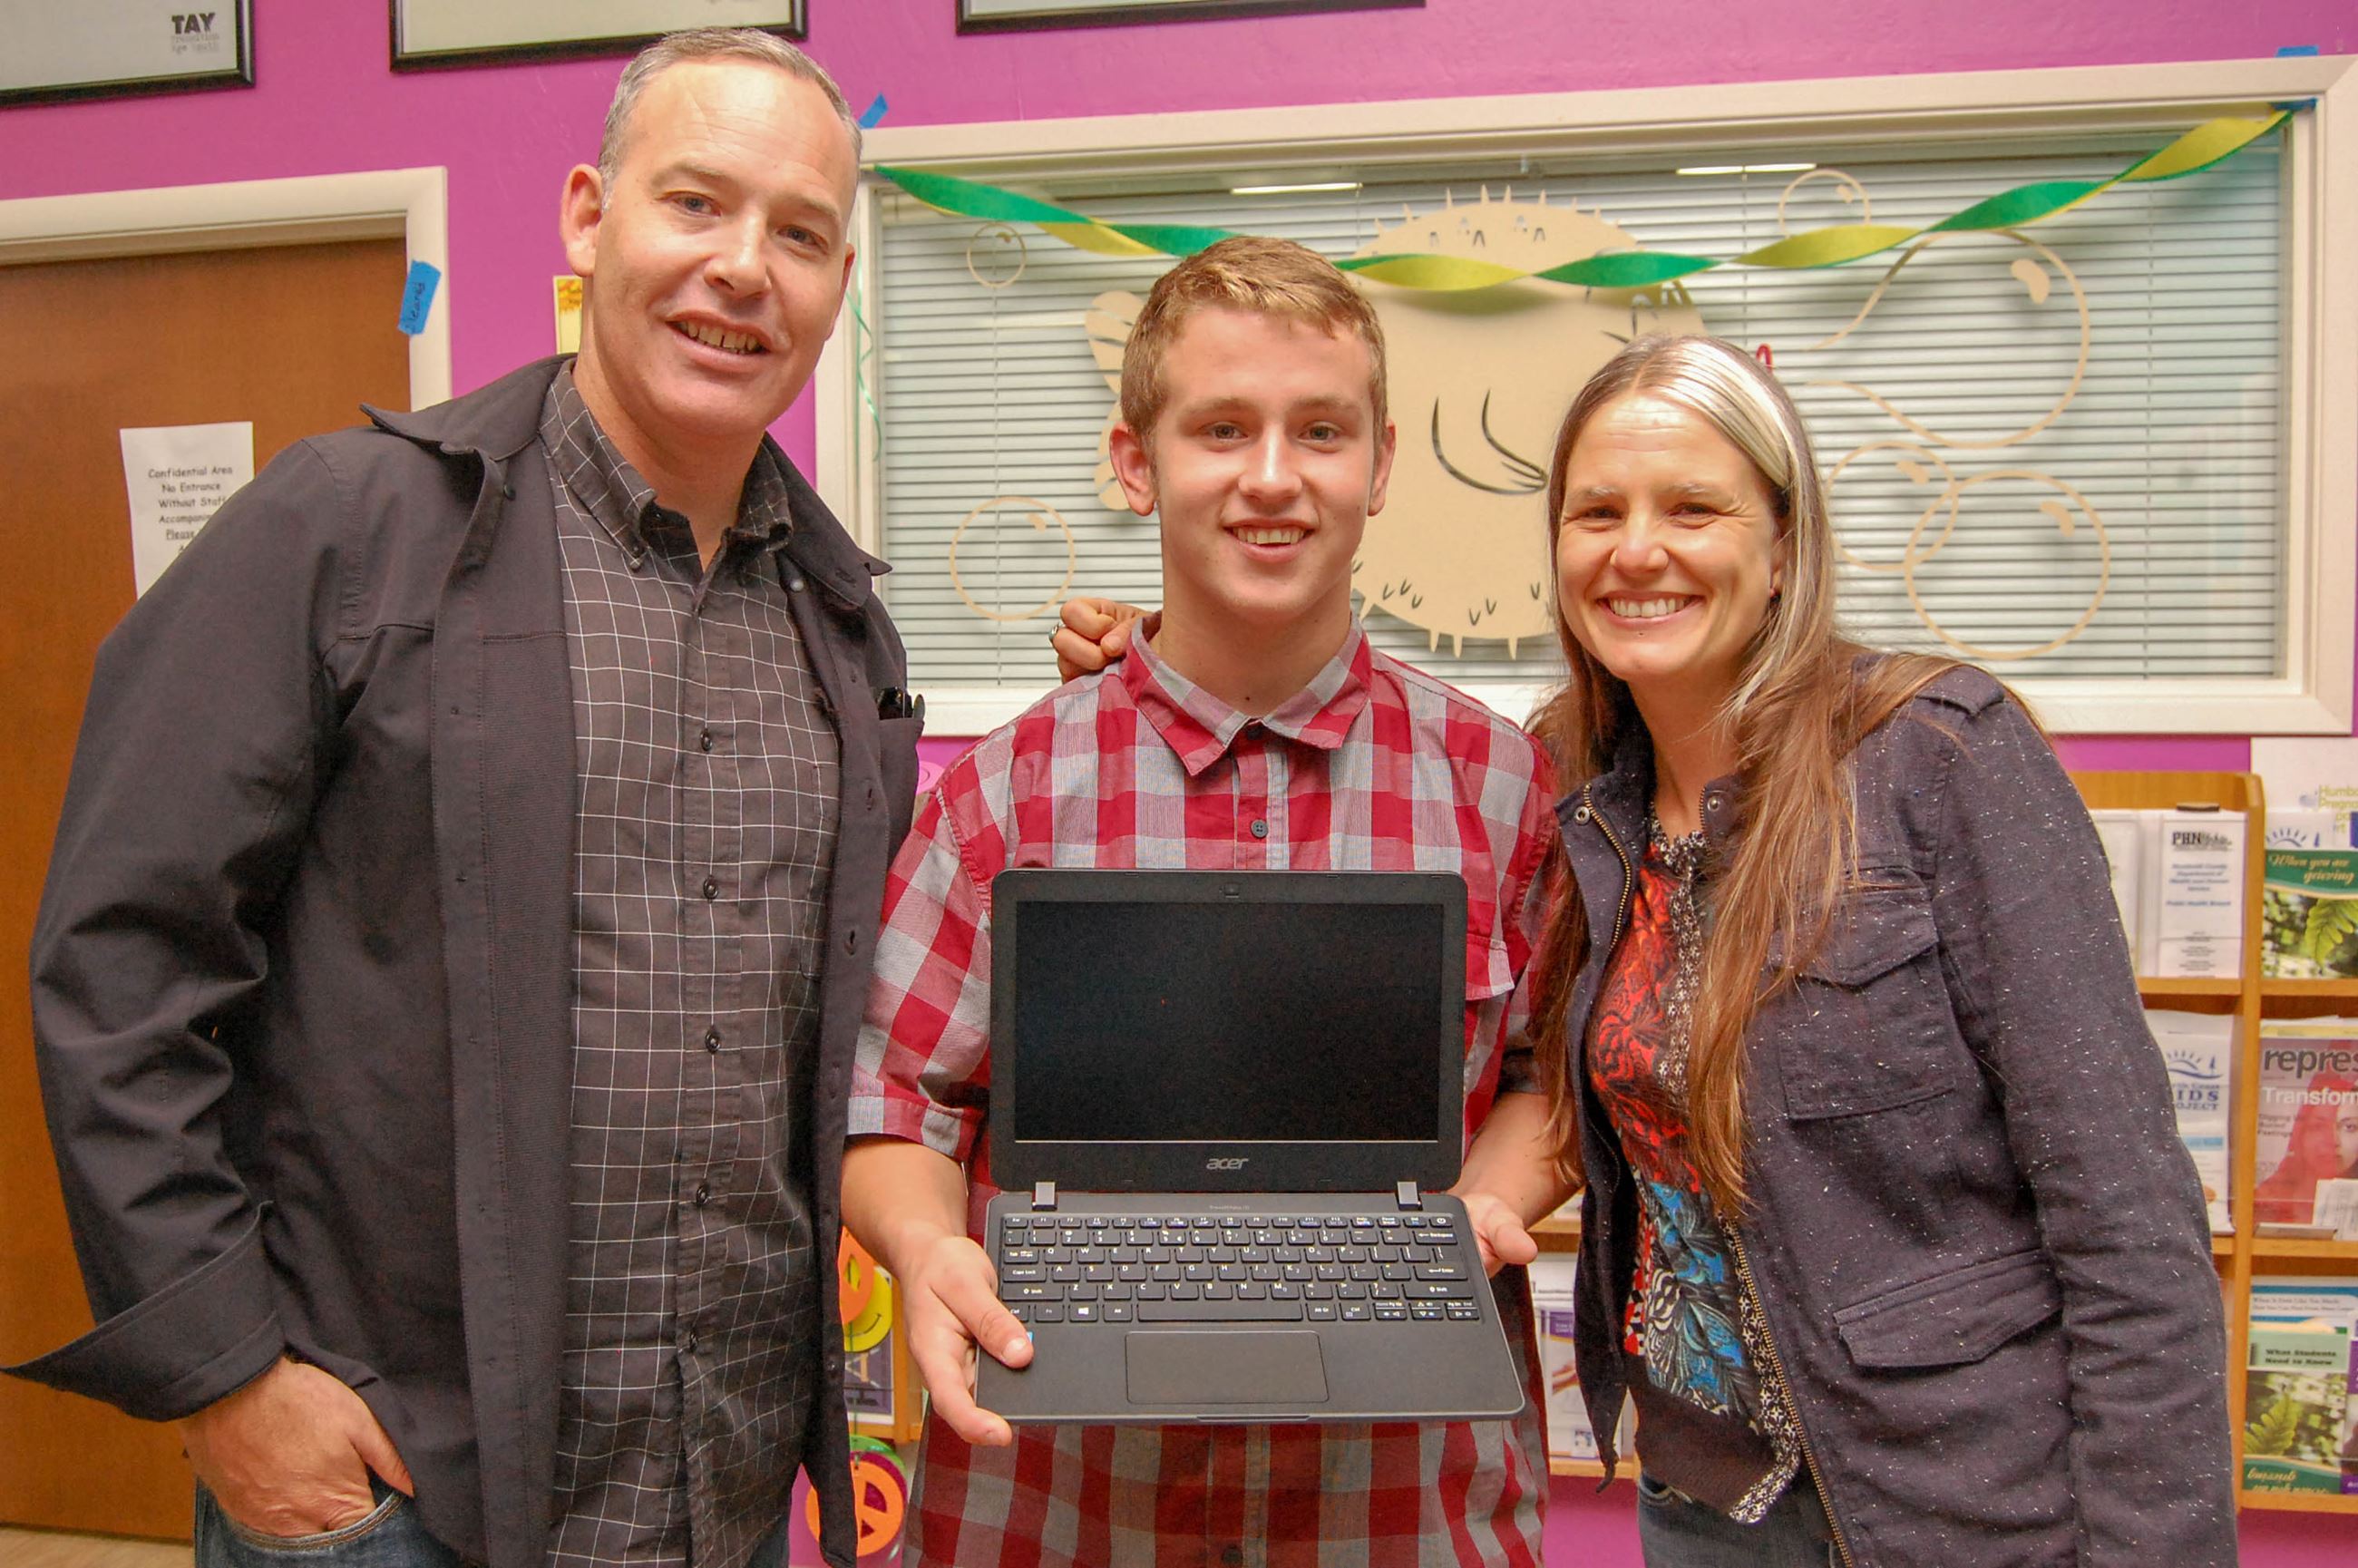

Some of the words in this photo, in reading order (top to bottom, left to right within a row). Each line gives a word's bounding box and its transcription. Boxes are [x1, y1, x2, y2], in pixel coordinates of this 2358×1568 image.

[171, 13, 216, 34] TAY
[148, 467, 207, 479] Confidential
[211, 466, 233, 475] Area
[161, 484, 176, 492] No
[180, 482, 220, 492] Entrance
[158, 498, 196, 509] Without
[2309, 857, 2331, 870] you
[2304, 870, 2355, 885] grieving
[2178, 1090, 2219, 1102] IDS
[2176, 1103, 2219, 1111] OJECT
[1206, 1157, 1249, 1170] acer
